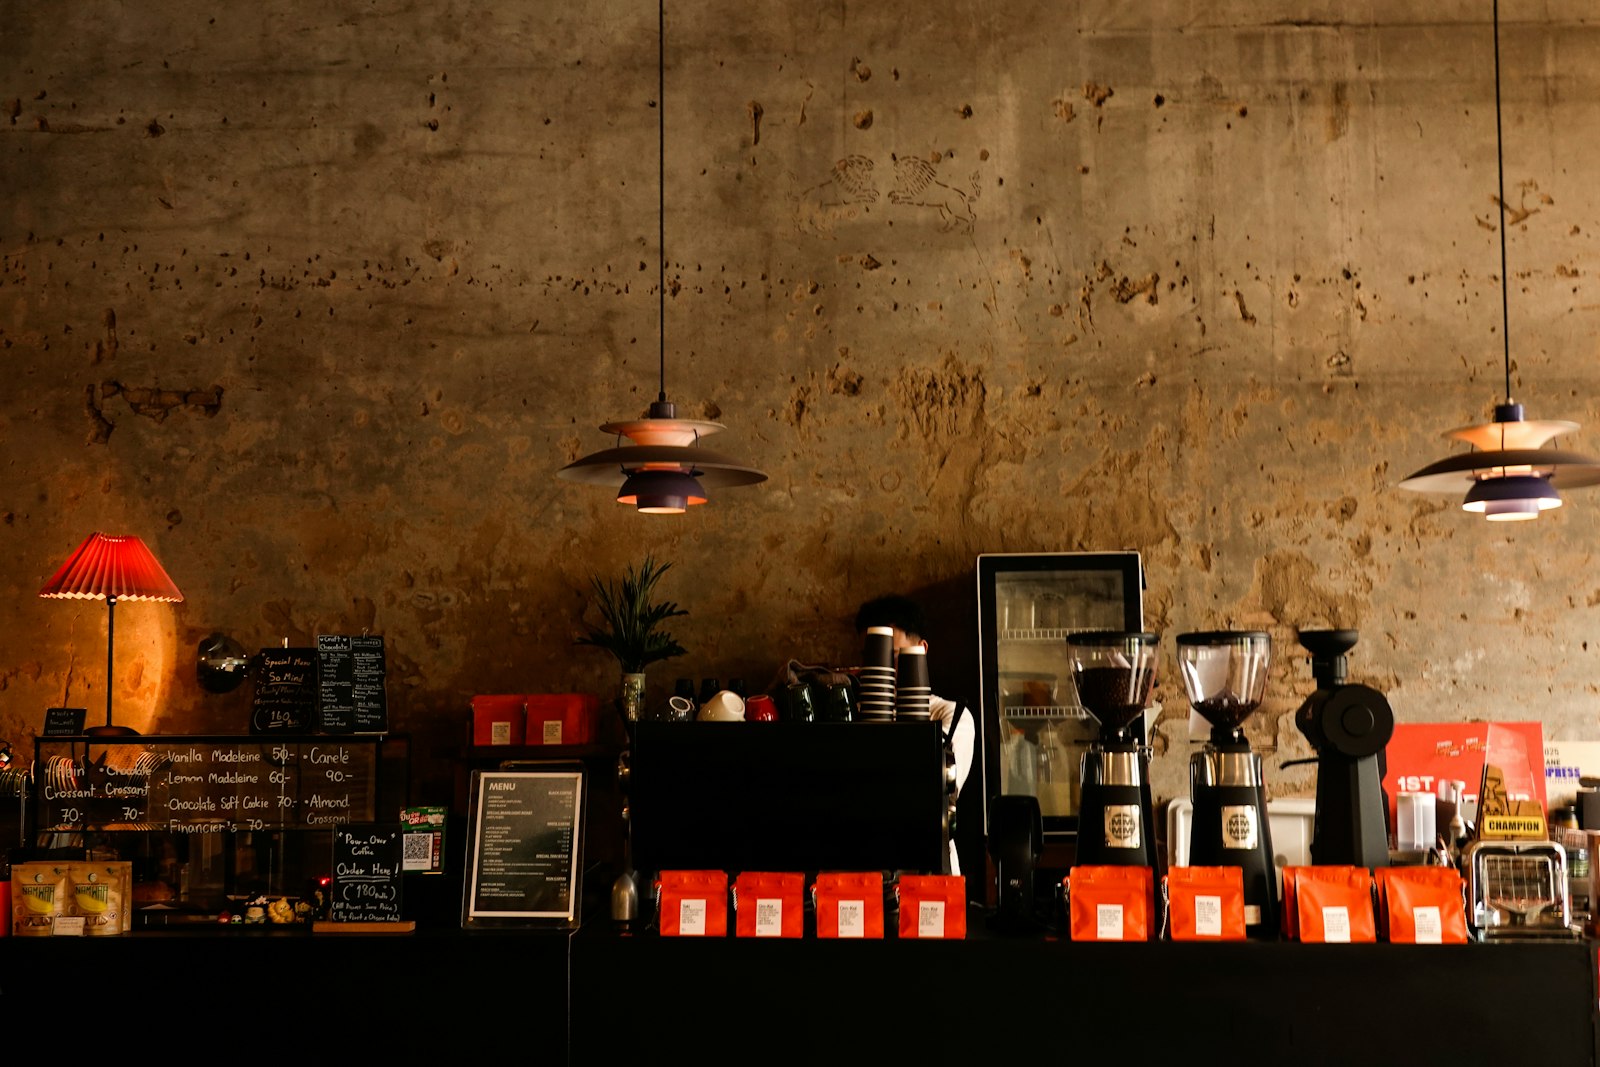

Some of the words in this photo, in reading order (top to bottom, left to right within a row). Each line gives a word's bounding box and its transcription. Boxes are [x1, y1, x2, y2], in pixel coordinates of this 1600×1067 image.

[264, 656, 291, 669] Special
[270, 710, 290, 722] 160
[167, 748, 203, 763] Vanilla
[211, 749, 261, 763] Madeleine
[310, 746, 350, 764] Canelé
[1545, 748, 1559, 756] 025
[168, 771, 203, 785] Lemon
[208, 771, 259, 784] Madeleine
[1545, 767, 1580, 778] PRESS
[105, 781, 151, 798] Crossant
[489, 782, 516, 790] MENU
[1397, 776, 1435, 791] 1ST
[45, 783, 96, 800] Crossant
[169, 797, 216, 811] Chocolate
[220, 796, 239, 810] Soft
[242, 796, 269, 810] Cookie
[309, 794, 350, 809] Almond
[169, 819, 237, 834] Financier's
[1489, 820, 1539, 831] CHAMPION
[336, 862, 365, 876] Order
